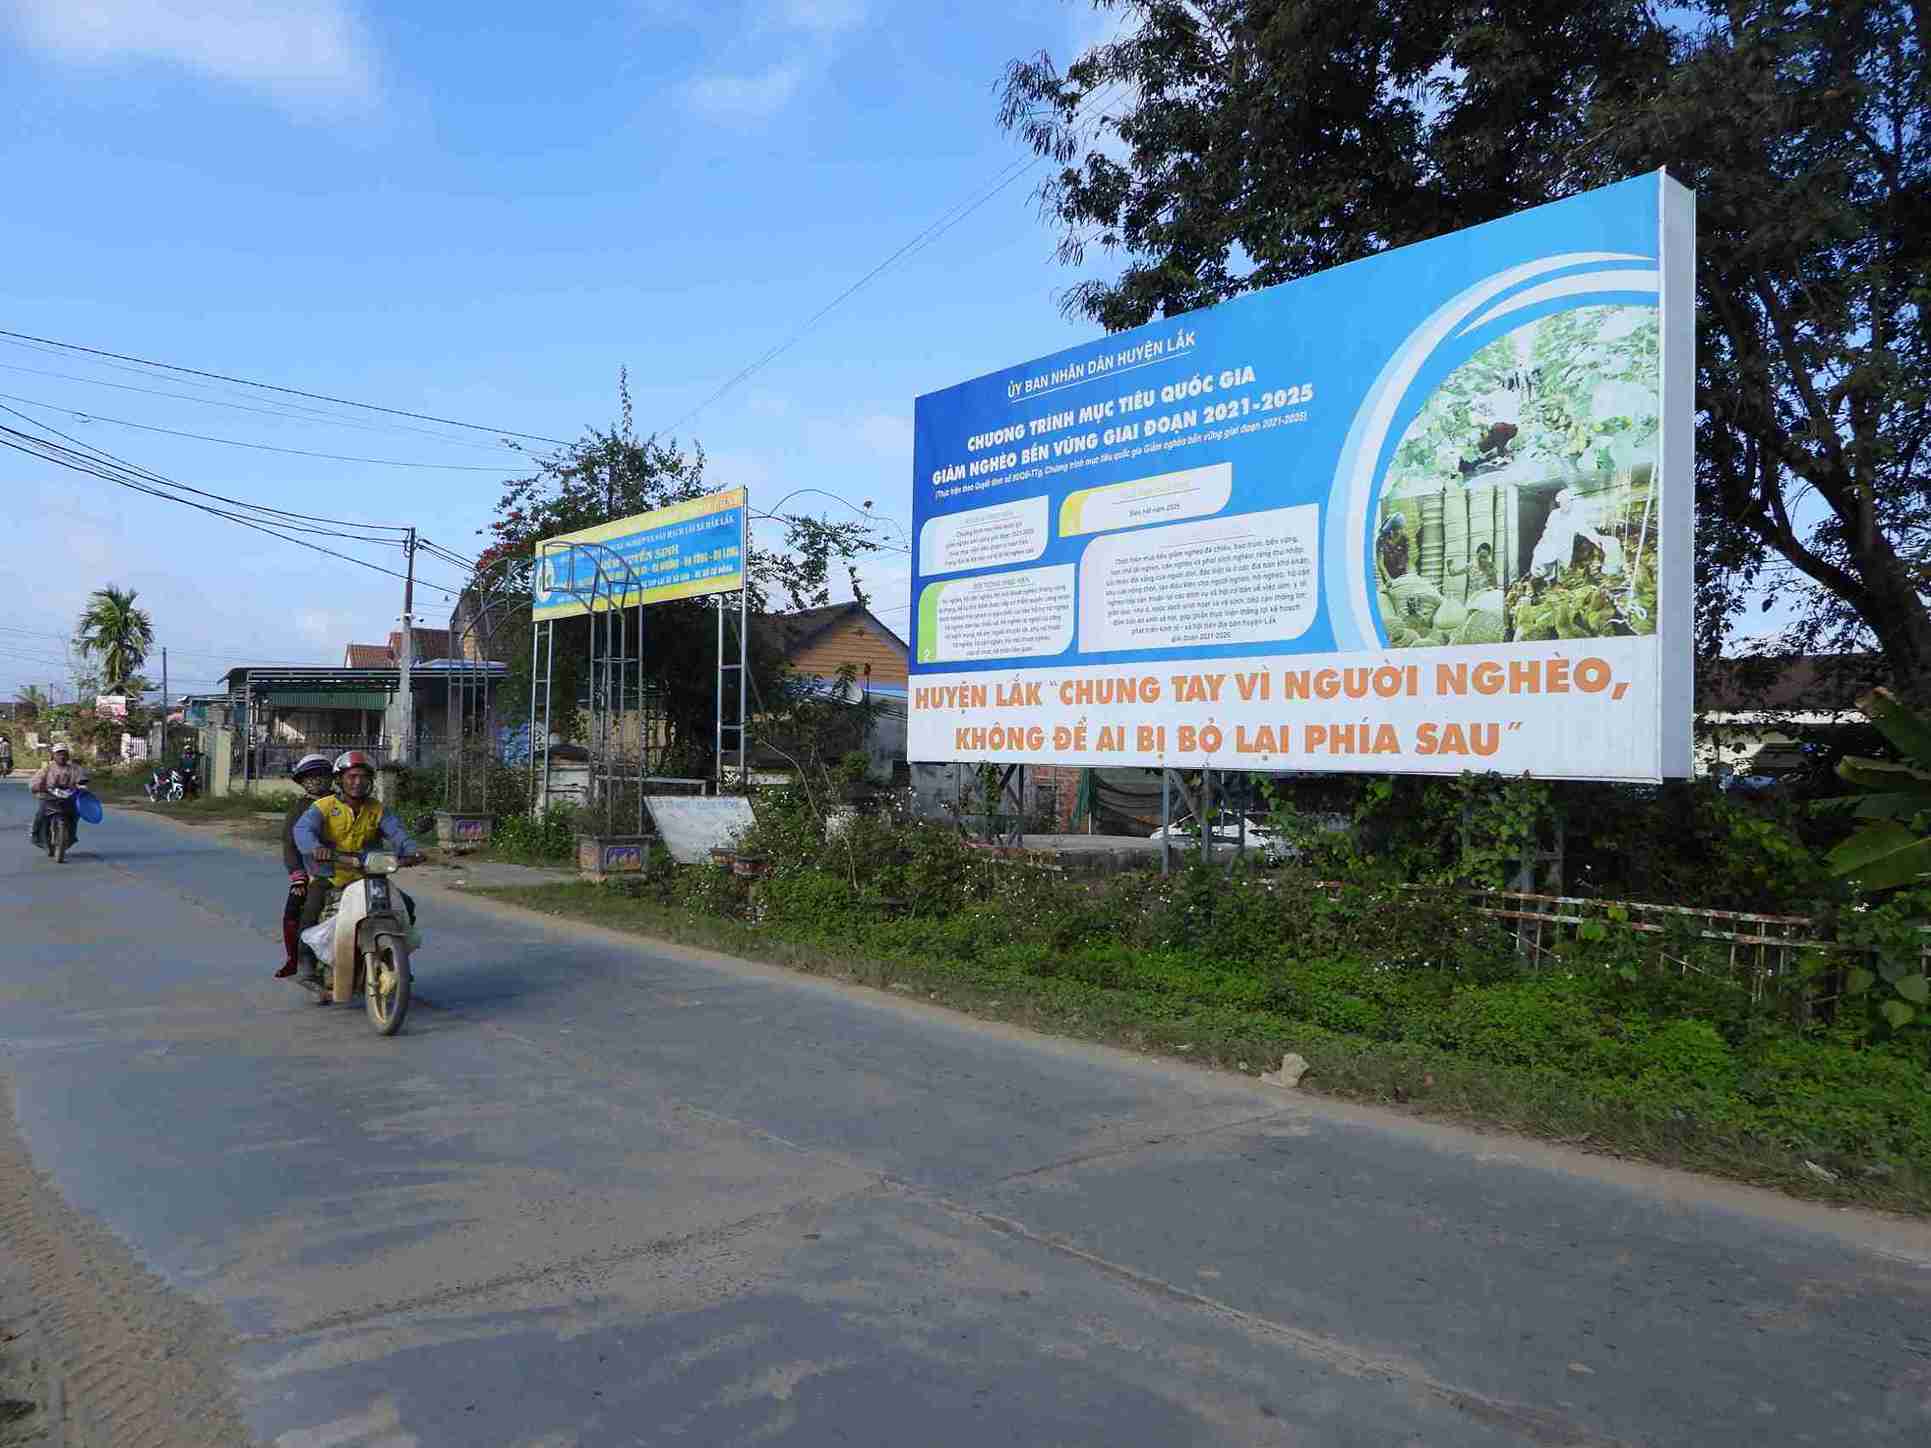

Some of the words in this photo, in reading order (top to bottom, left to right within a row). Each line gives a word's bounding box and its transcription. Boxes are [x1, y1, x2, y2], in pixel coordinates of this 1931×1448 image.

[1024, 374, 1048, 393] BAN
[1051, 363, 1085, 385] NHÂN
[1087, 354, 1114, 375] DÂN
[1117, 340, 1163, 367] HUYỆN
[1079, 400, 1114, 425] MỤC
[1119, 389, 1155, 414] TIÊU
[1219, 365, 1257, 389] GIA
[1103, 423, 1138, 446] GIAI
[1143, 409, 1198, 437] ĐOẠN
[1202, 383, 1314, 424] 2021-2025
[914, 680, 987, 715] HUYỆN
[995, 673, 1043, 708] LẮK
[1171, 673, 1225, 703] TAY
[1235, 664, 1270, 701] VÌ
[1284, 658, 1418, 700] NGƯỜI
[1435, 651, 1632, 701] NGHÈO,
[954, 721, 1044, 752] KHÔNG
[1053, 716, 1088, 752] ĐỂ
[1096, 726, 1126, 752] AI
[1136, 726, 1165, 760] BỊ
[1178, 717, 1223, 753] BỎ
[1236, 721, 1290, 762] LẠI
[1304, 716, 1401, 755] PHÍA
